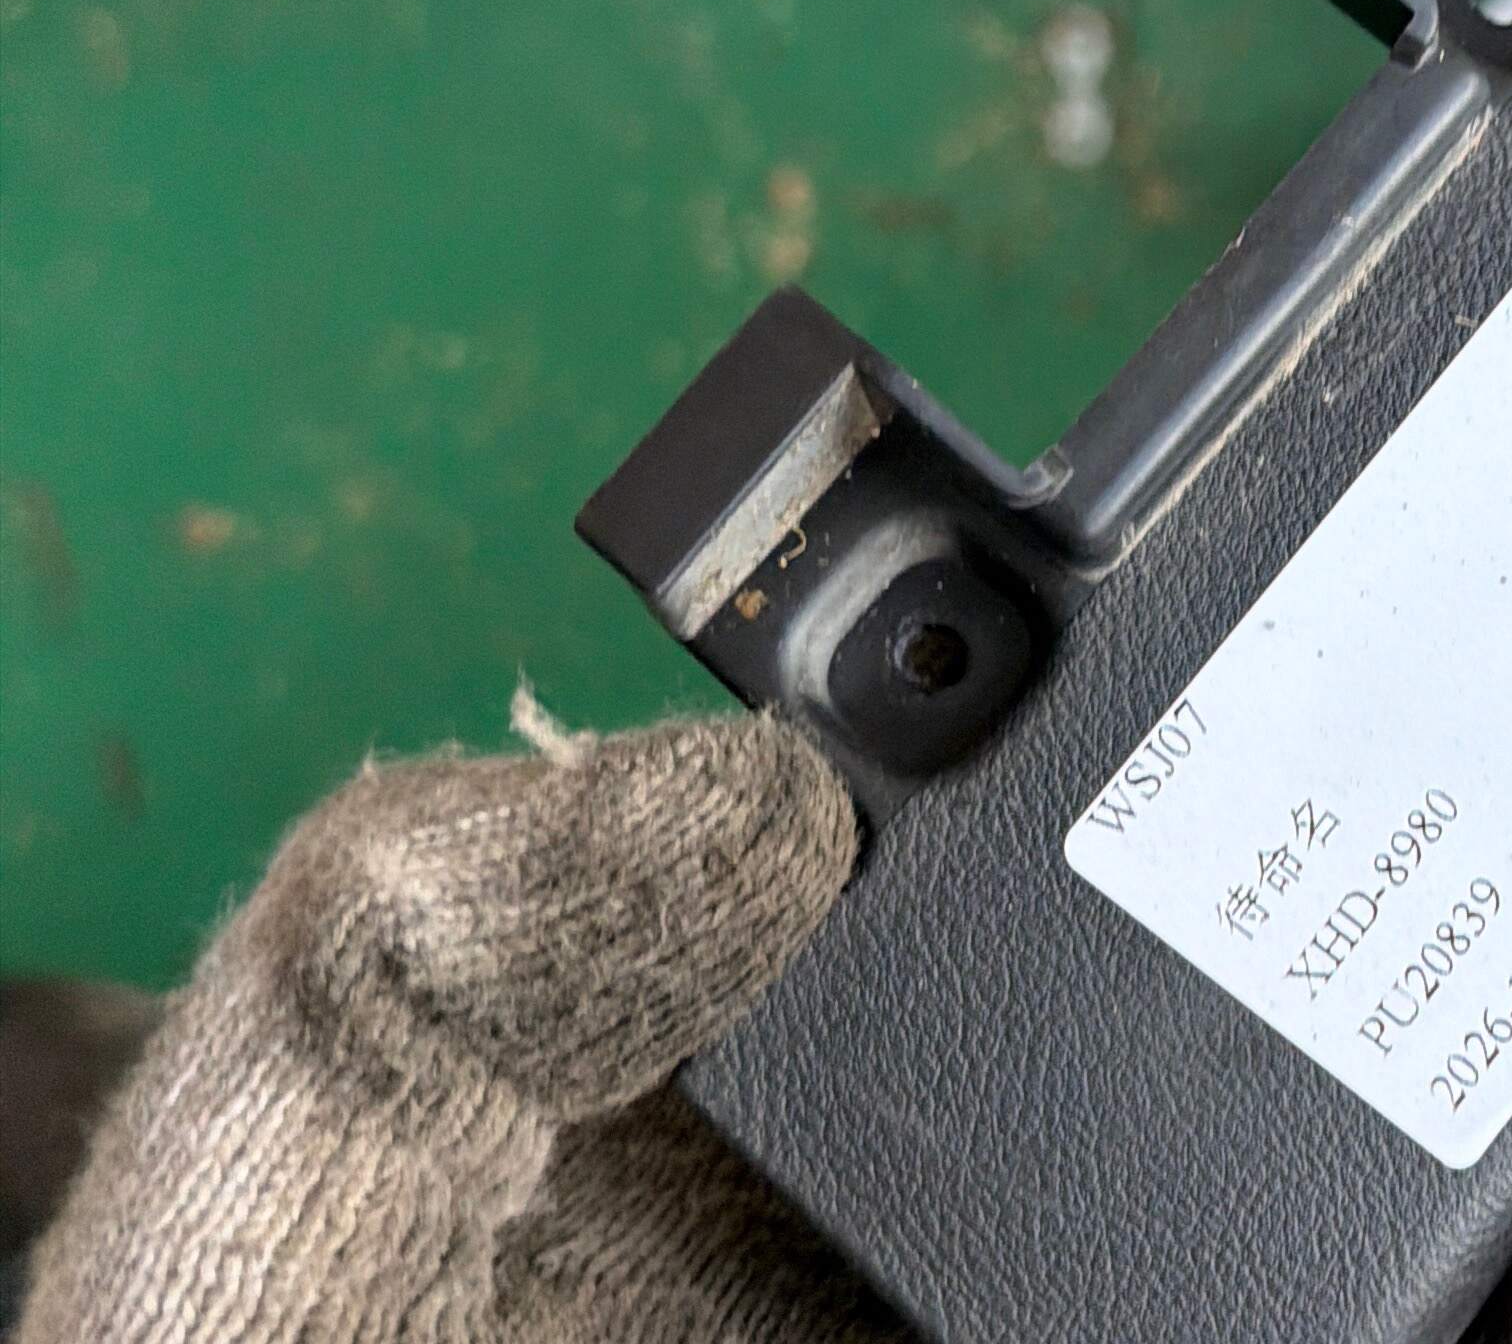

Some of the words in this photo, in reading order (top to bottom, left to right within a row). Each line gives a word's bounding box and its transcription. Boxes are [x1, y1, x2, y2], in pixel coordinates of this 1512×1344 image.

[1087, 698, 1208, 836] WSJ07
[1215, 798, 1341, 941] 待命名
[1285, 788, 1458, 998] XHD-8980
[1358, 877, 1501, 1056] PU20839
